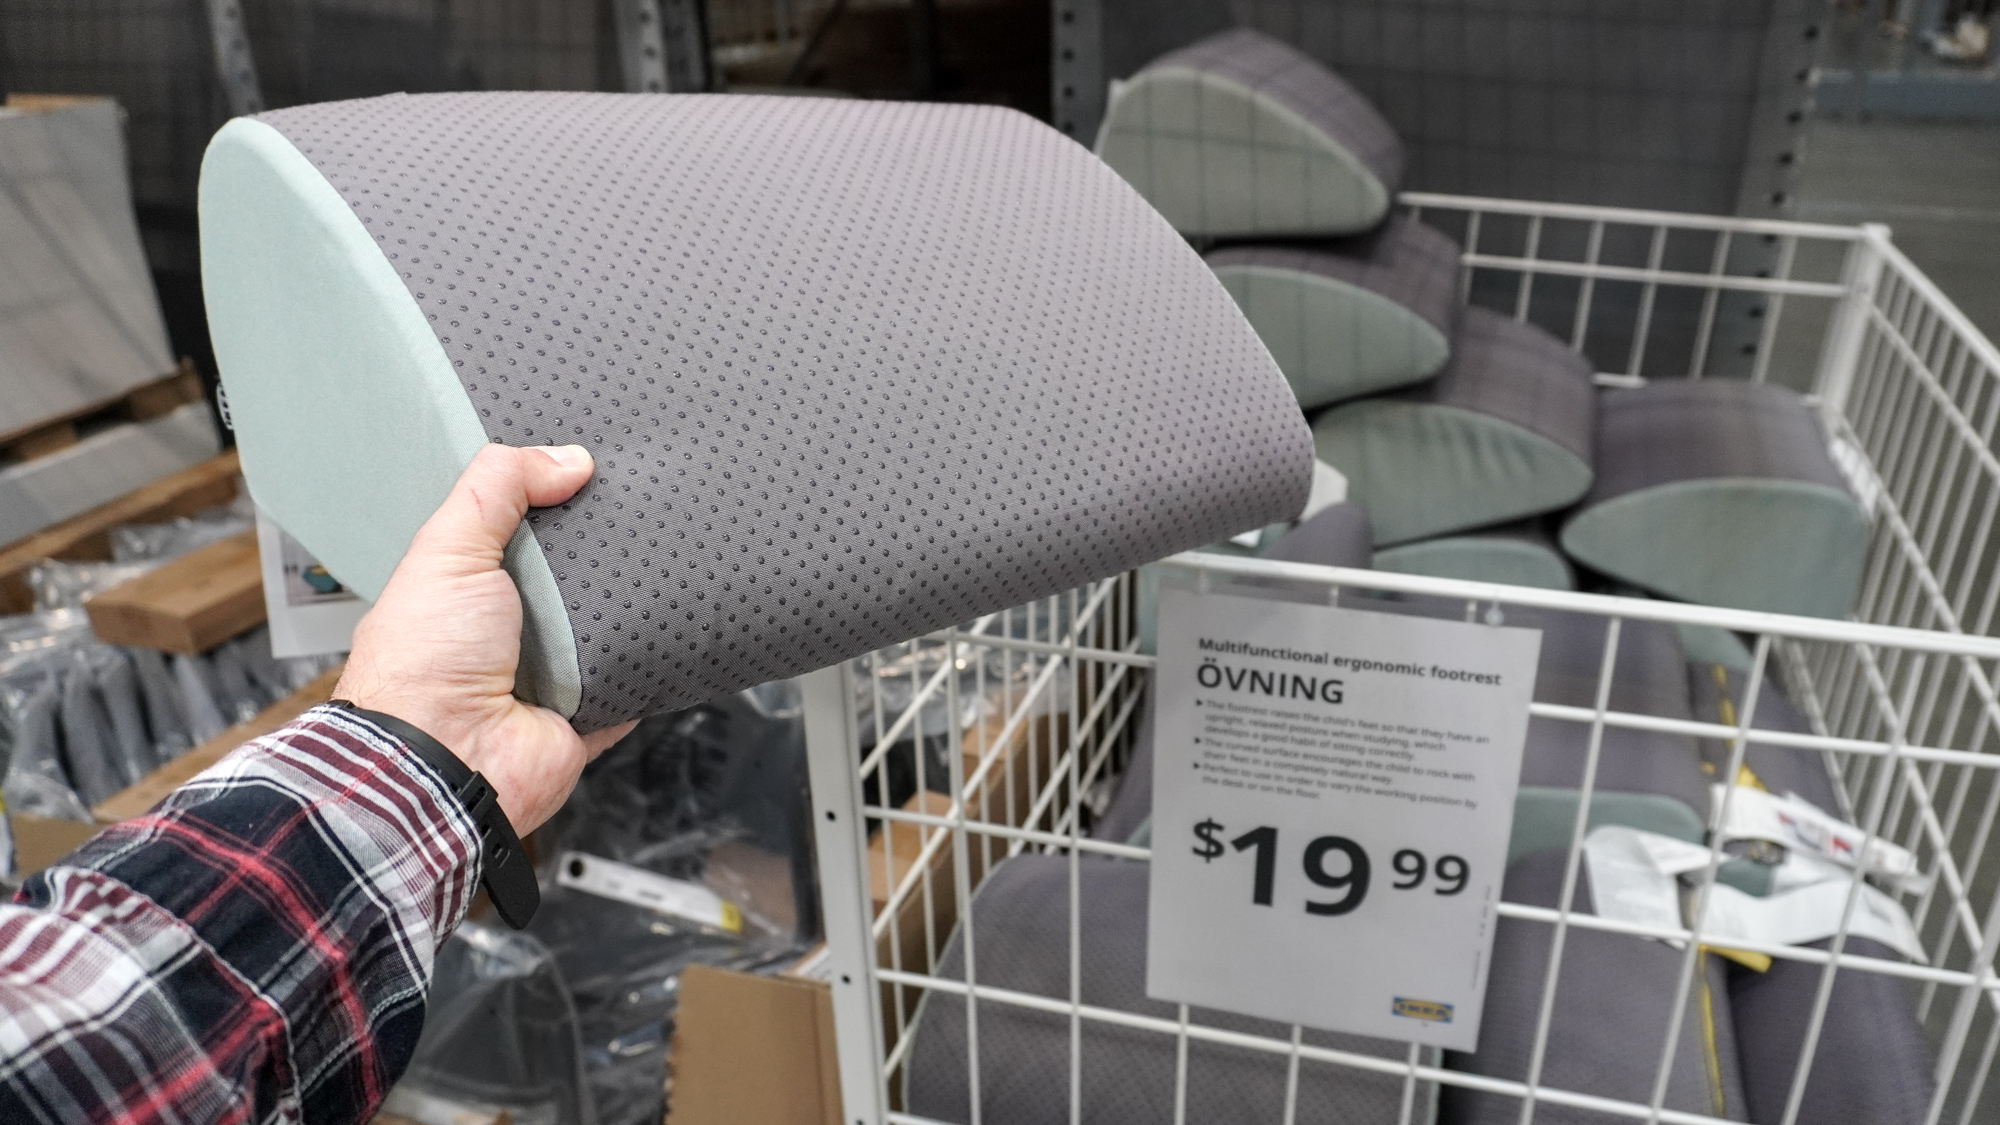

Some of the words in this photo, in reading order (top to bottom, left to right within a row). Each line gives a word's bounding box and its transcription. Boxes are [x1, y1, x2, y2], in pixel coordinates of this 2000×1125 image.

[1197, 657, 1344, 704] ÖVNING
[1199, 638, 1328, 665] Multifunctional
[1334, 655, 1425, 676] ergonomic
[1431, 666, 1501, 685] footrest
